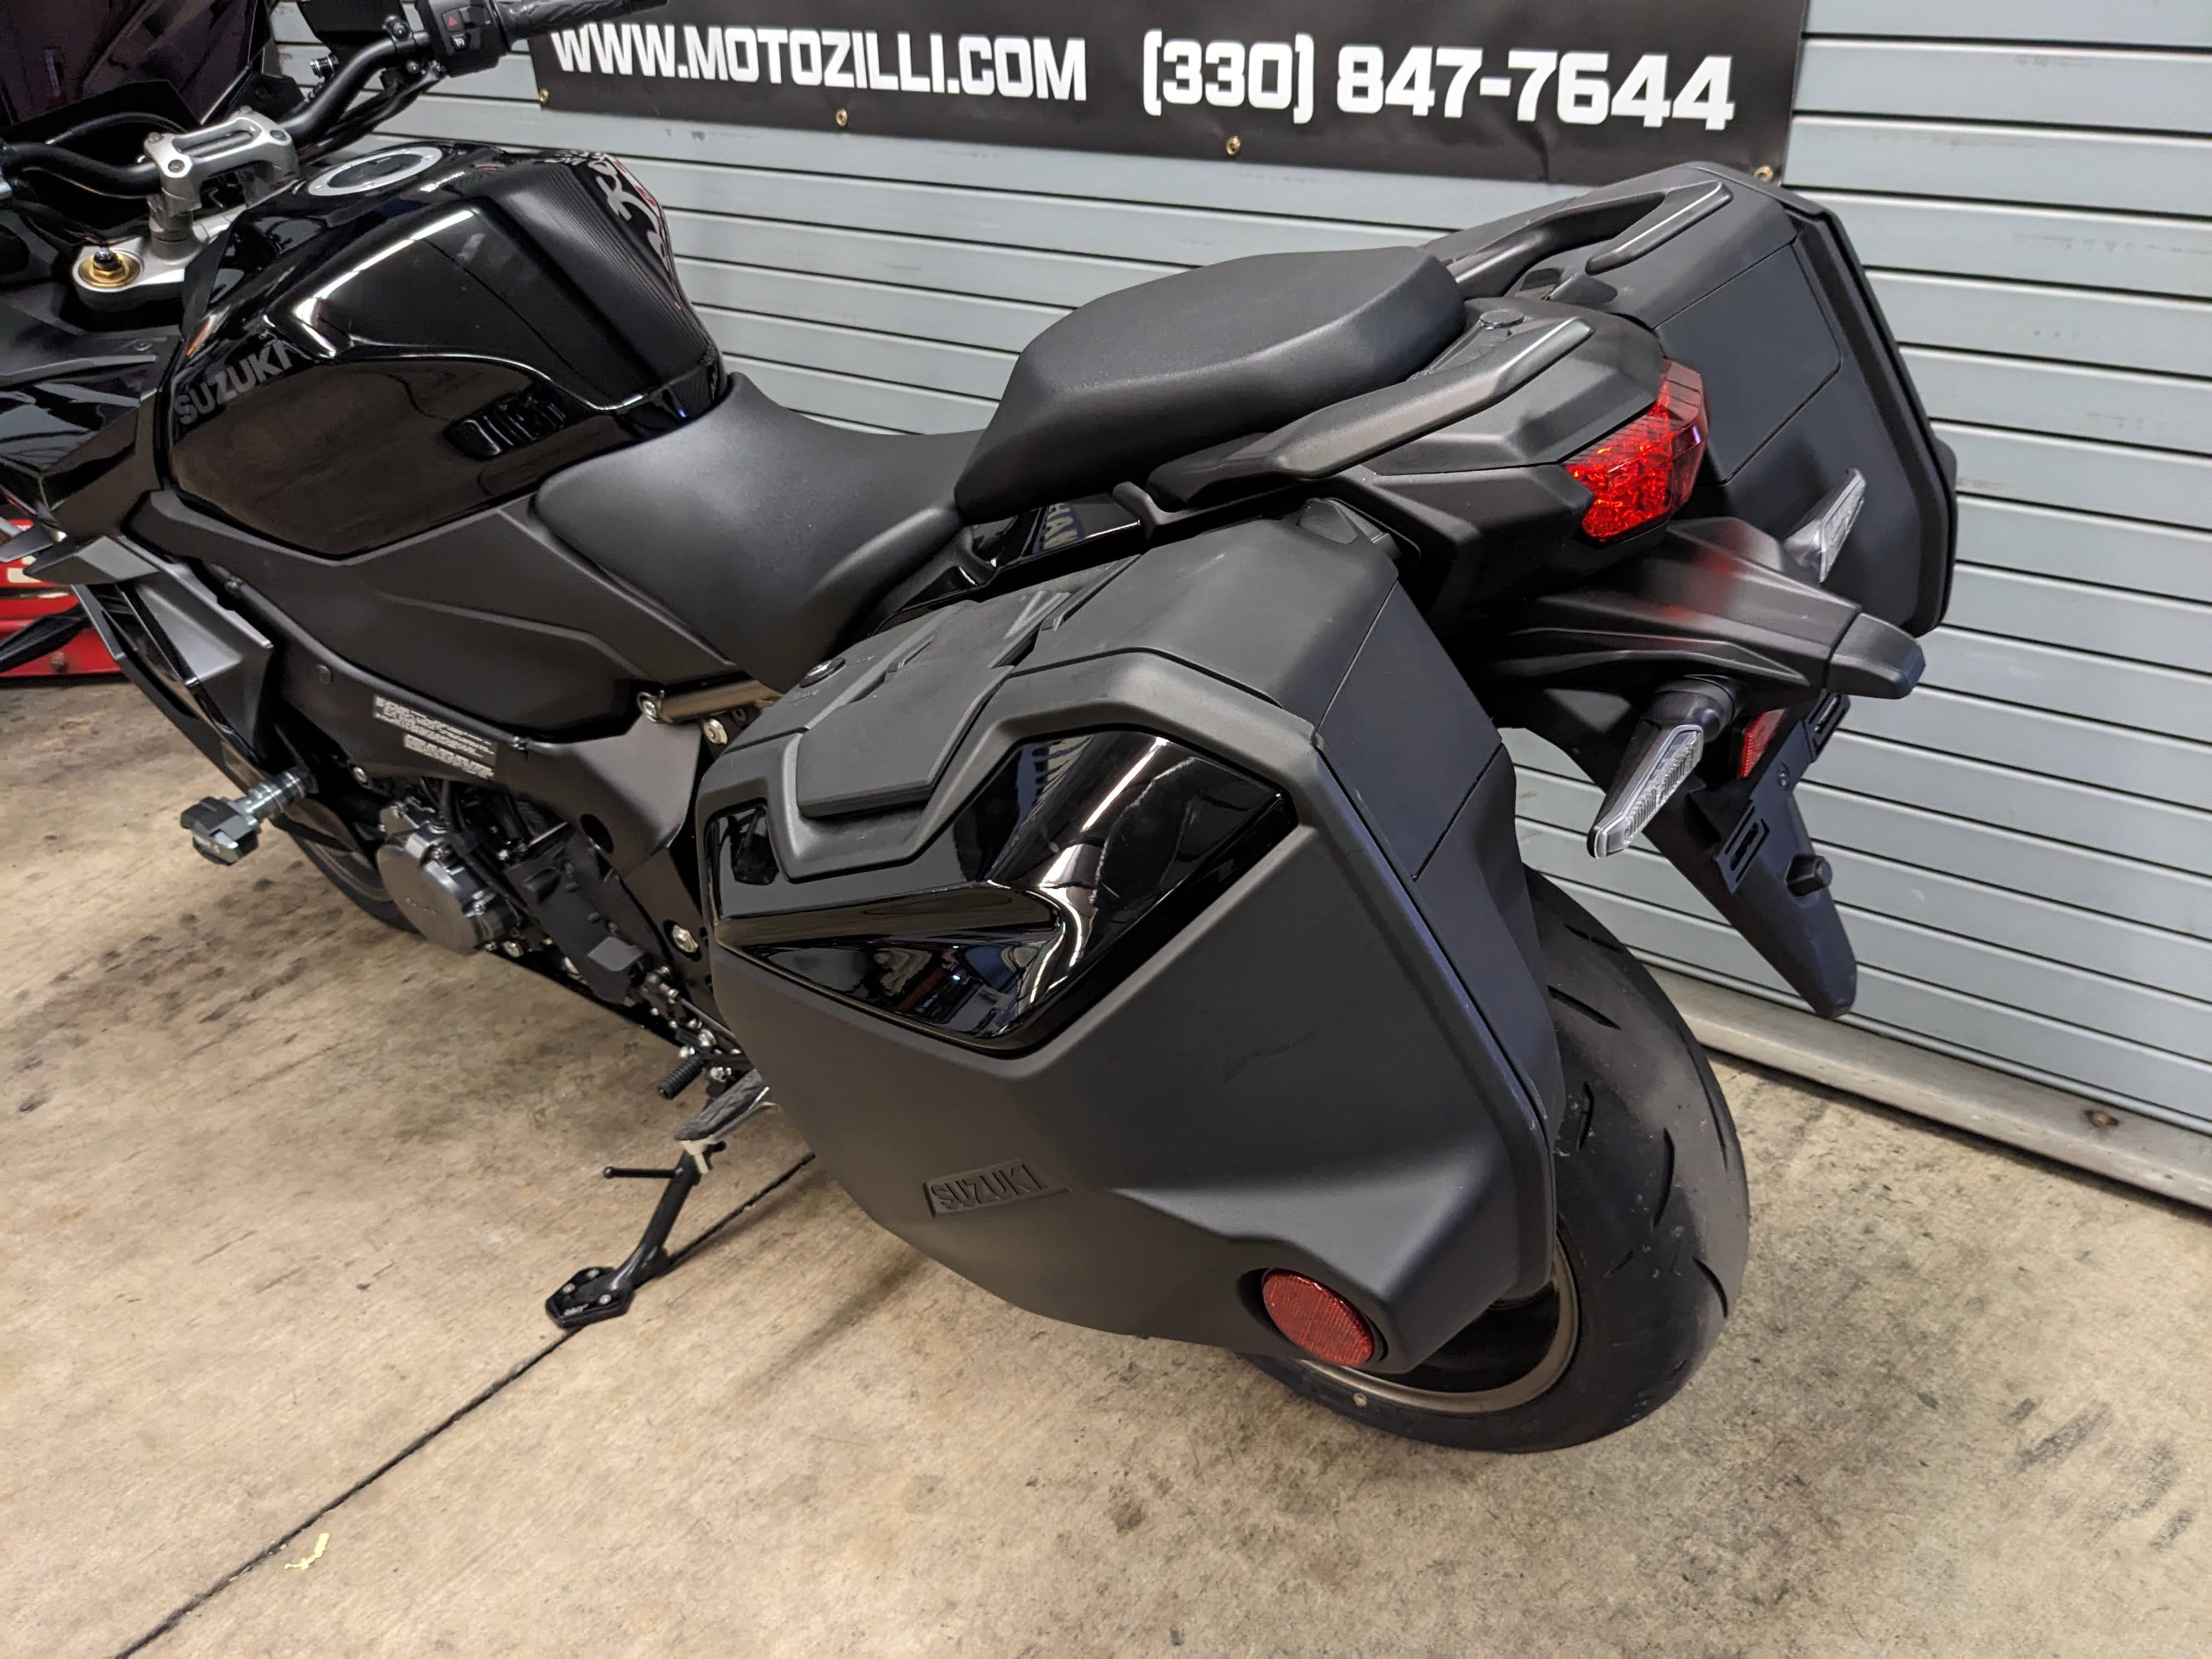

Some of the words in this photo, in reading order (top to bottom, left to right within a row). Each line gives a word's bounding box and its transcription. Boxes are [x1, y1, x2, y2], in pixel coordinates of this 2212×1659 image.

[550, 22, 1087, 101] WWW.MOTOZILLI.COM
[1143, 29, 1315, 125] (330)
[1336, 45, 1735, 131] 847-7644
[174, 338, 293, 425] SUZUKI
[930, 1163, 1046, 1210] SUZUKI
